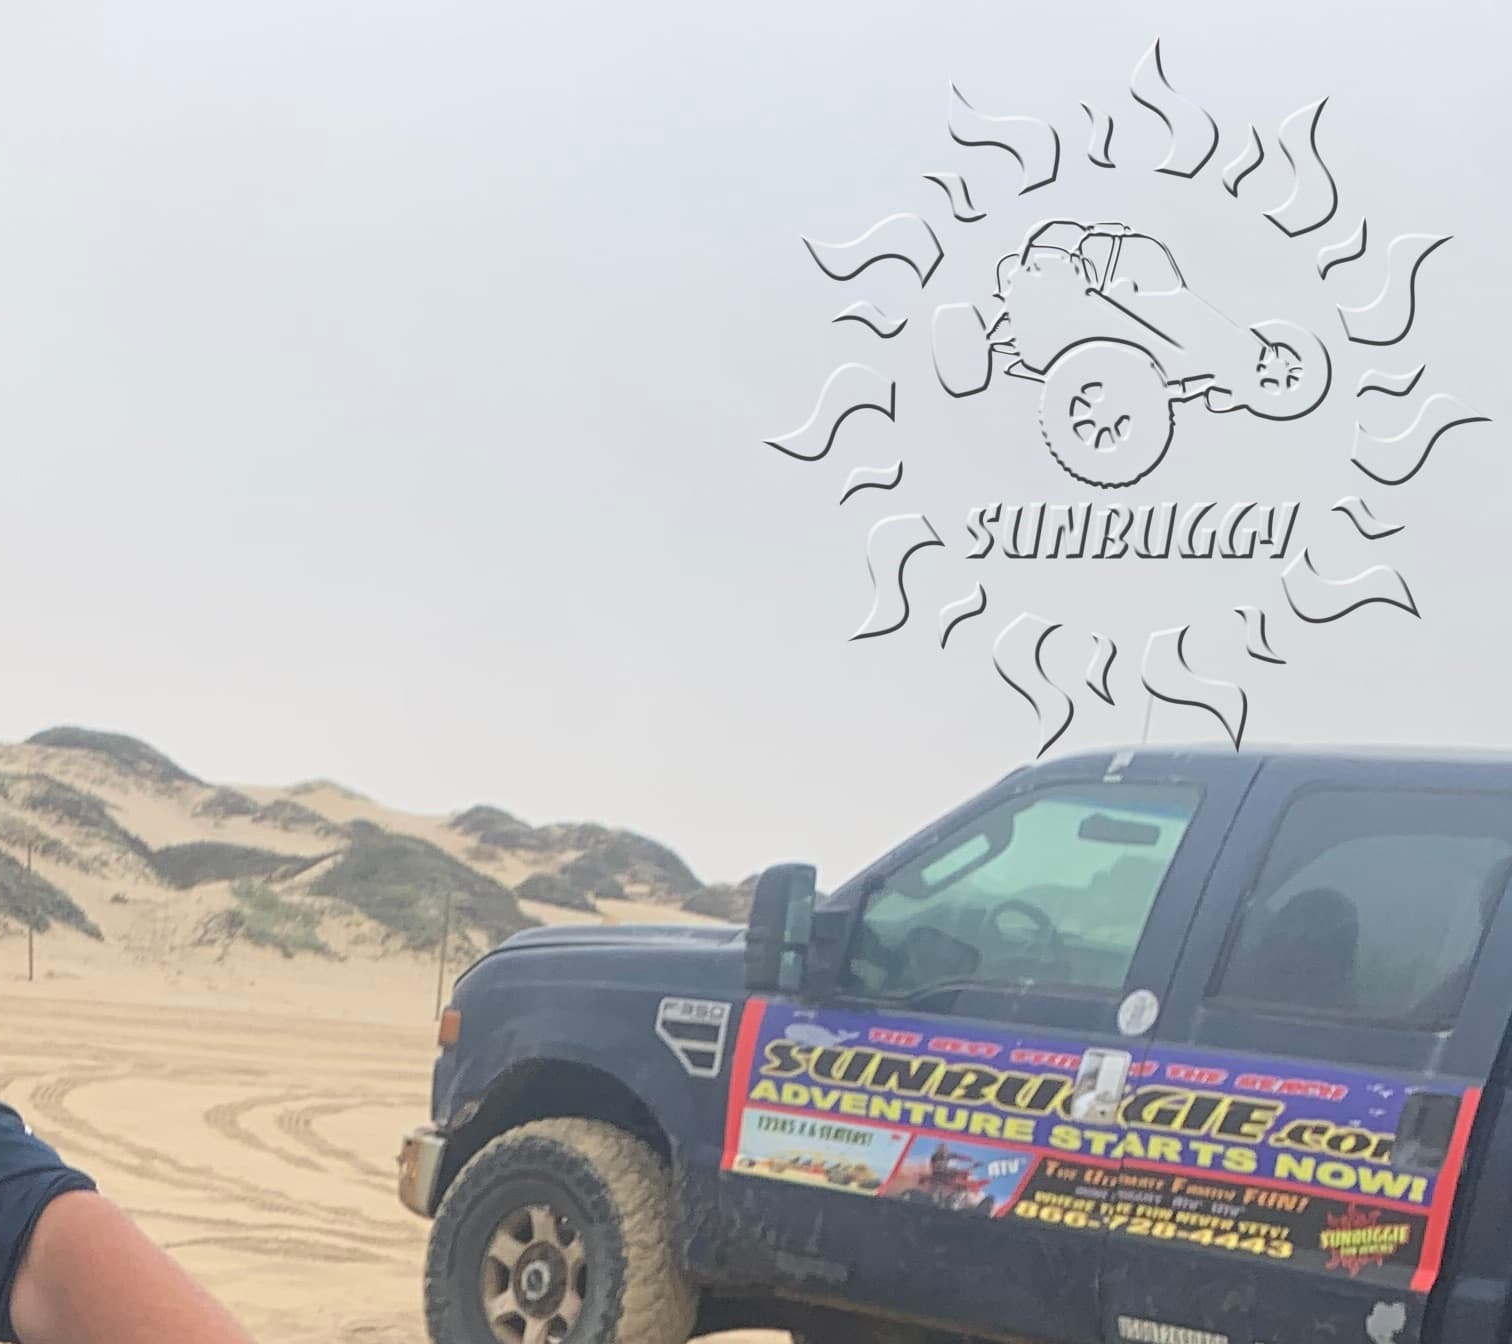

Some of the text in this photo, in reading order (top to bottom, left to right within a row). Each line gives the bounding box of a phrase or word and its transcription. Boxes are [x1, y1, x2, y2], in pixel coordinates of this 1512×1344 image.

[749, 1079, 1429, 1203] ADVENTURE STARTS NOW!
[1014, 1199, 1294, 1259] 866-728-4443
